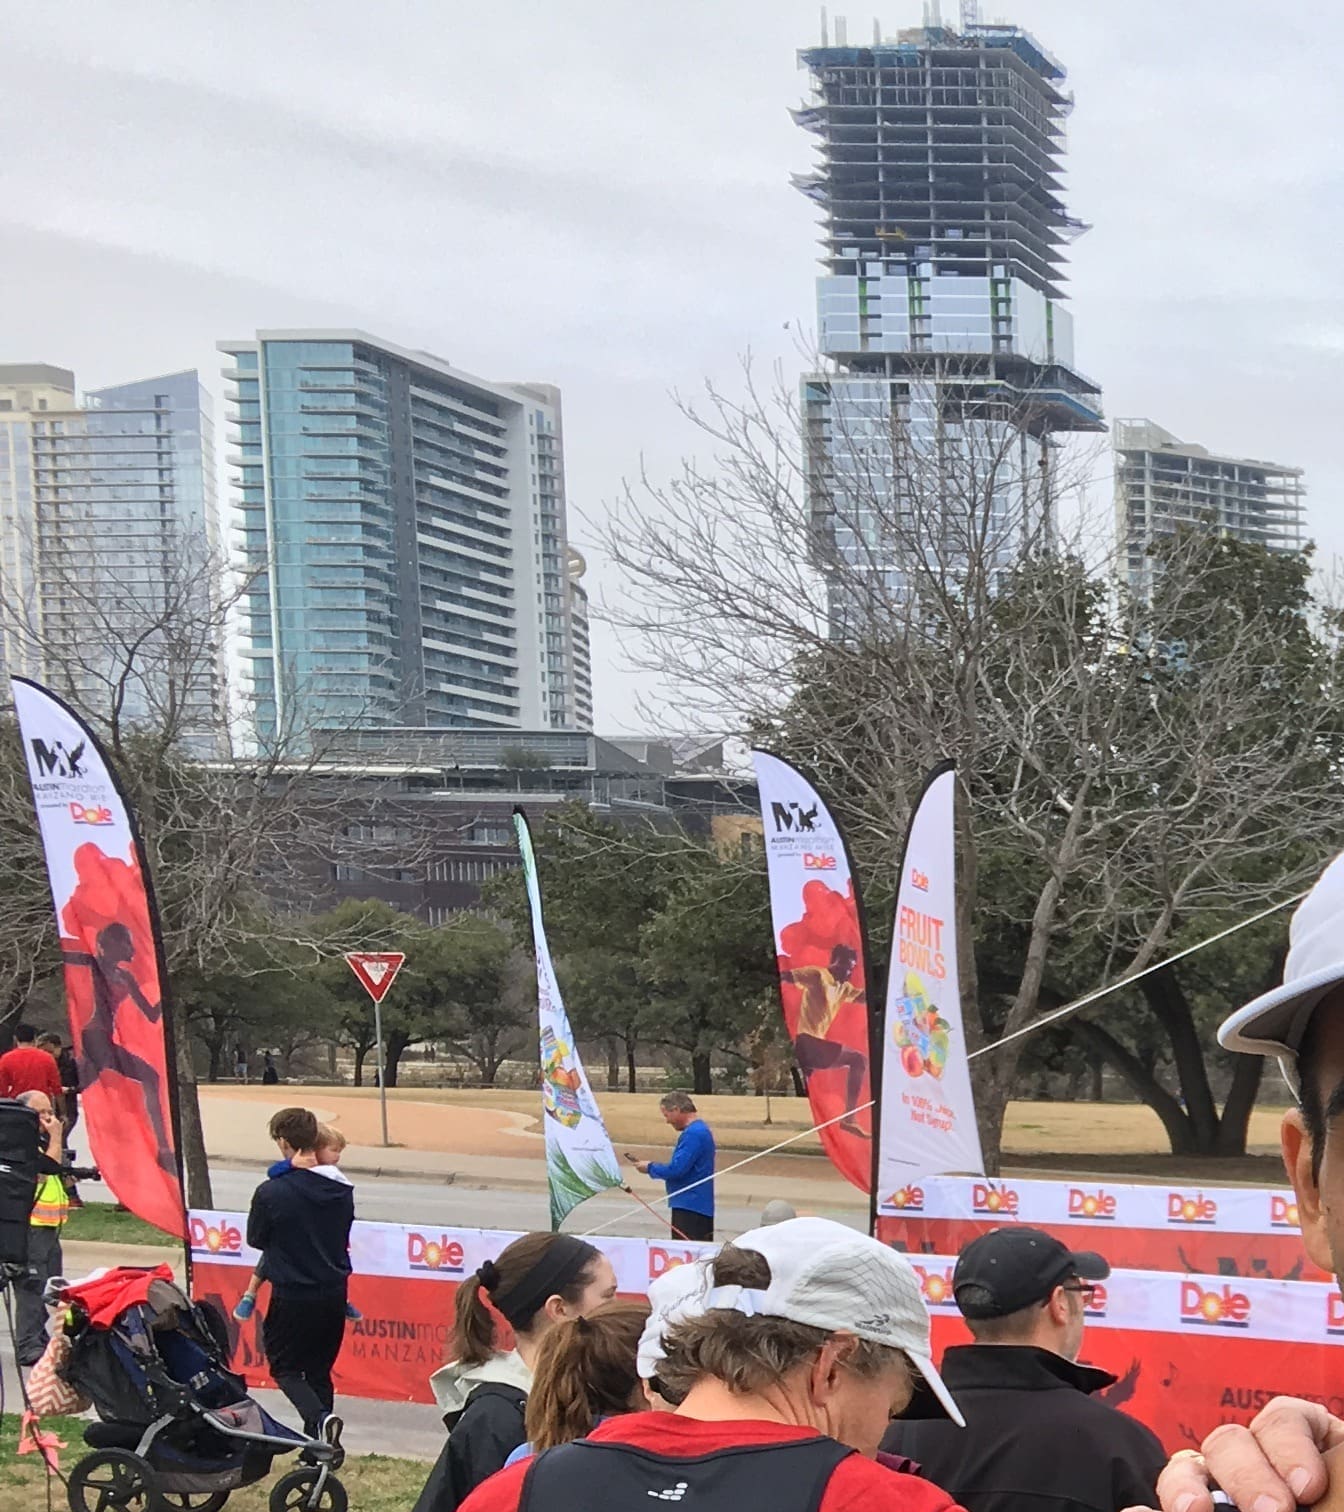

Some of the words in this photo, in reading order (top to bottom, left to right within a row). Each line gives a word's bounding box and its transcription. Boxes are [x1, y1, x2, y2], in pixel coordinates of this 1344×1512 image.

[69, 802, 113, 824] Dole
[803, 853, 837, 869] Dole
[900, 905, 944, 951] FRUIT
[899, 938, 946, 980] BOWLS
[973, 1184, 1019, 1212] Dole
[1068, 1188, 1117, 1216] Dole
[1168, 1193, 1217, 1222] Dole
[190, 1217, 242, 1252] Dole
[408, 1231, 465, 1268] Dole
[1180, 1281, 1251, 1322] Dole
[352, 1342, 443, 1365] MANZAN
